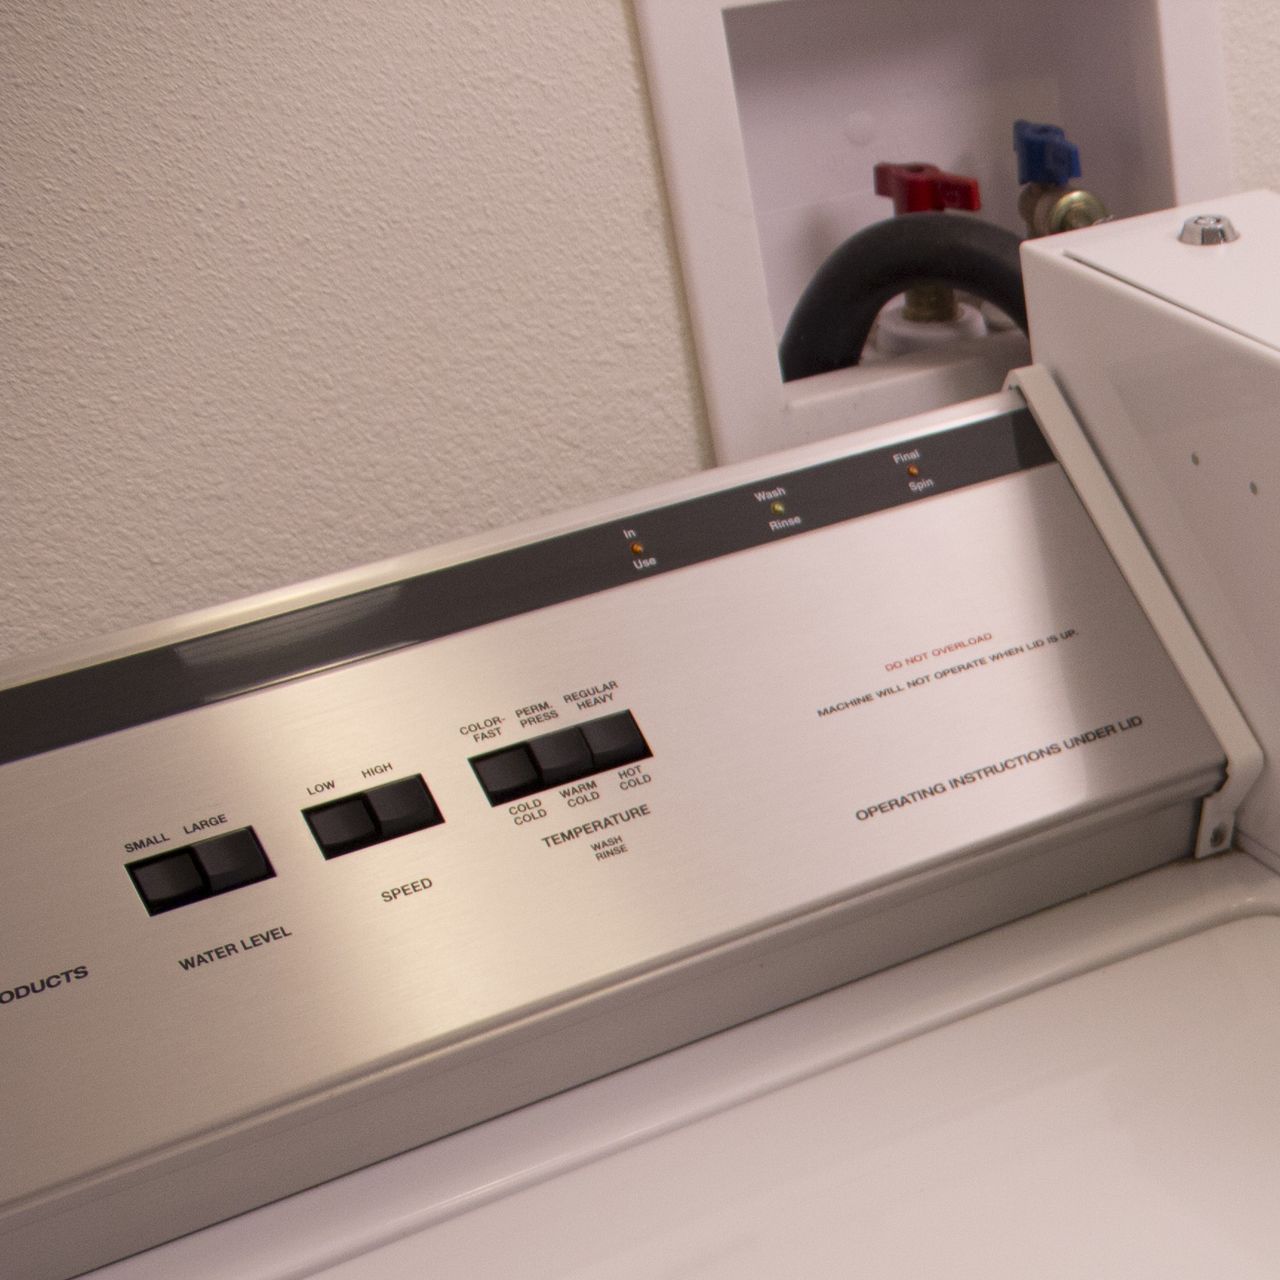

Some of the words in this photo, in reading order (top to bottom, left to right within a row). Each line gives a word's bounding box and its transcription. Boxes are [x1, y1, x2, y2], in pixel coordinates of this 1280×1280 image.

[893, 450, 920, 464] Final
[753, 486, 786, 502] Wash
[908, 477, 934, 493] Spin
[769, 515, 802, 532] Rinse
[623, 528, 636, 539] In
[633, 556, 657, 570] Use
[884, 662, 903, 672] DO
[905, 653, 928, 666] NOT
[931, 632, 993, 657] OVERLOAD
[817, 693, 874, 718] MACHINE
[875, 685, 904, 699] WILL
[906, 675, 931, 689] NOT
[933, 657, 988, 681] OPERATE
[988, 646, 1024, 663] WHEN
[1025, 639, 1045, 652] LID
[1047, 635, 1059, 644] IS
[563, 680, 619, 704] REGULAR
[514, 701, 554, 719] PERM.
[576, 692, 615, 711] HEAVY
[459, 715, 506, 736] COLOR-
[519, 709, 560, 729] PRESS
[473, 727, 502, 743] FAST
[361, 762, 394, 779] HIGH
[617, 765, 643, 780] HOT
[855, 782, 947, 822] OPERATING
[949, 743, 1062, 790] INSTRUCTIONS
[1063, 724, 1117, 750] UNDER
[1118, 715, 1143, 732] LID
[306, 779, 336, 796] LOW
[559, 780, 597, 799] WARM
[619, 774, 652, 791] COLD
[508, 798, 542, 816] COLD
[567, 791, 600, 809] COLD
[183, 813, 228, 835] LARGE
[513, 808, 548, 826] COLD
[541, 803, 651, 848] TEMPERATURE
[124, 832, 171, 854] SMALL
[590, 834, 623, 852] WASH
[595, 843, 628, 861] RINSE
[381, 877, 433, 903] SPEED
[178, 943, 239, 971] WATER
[240, 926, 293, 951] LEVEL
